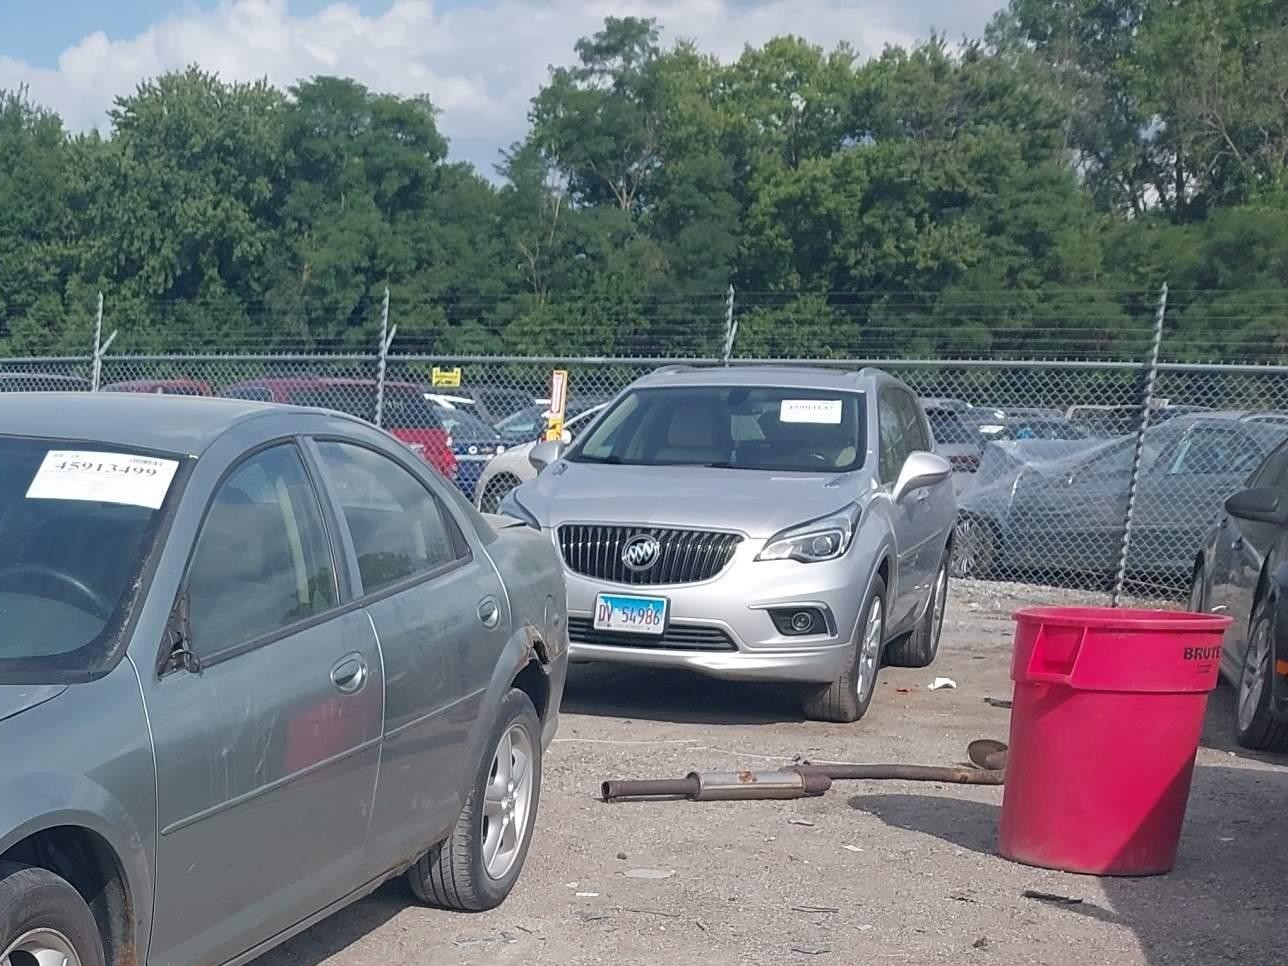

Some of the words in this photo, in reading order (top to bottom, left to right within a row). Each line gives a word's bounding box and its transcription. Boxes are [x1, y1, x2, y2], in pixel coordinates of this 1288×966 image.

[55, 460, 158, 476] 45913499
[599, 604, 613, 622] DV
[621, 606, 661, 626] 54986
[1183, 645, 1221, 660] BRUTE
